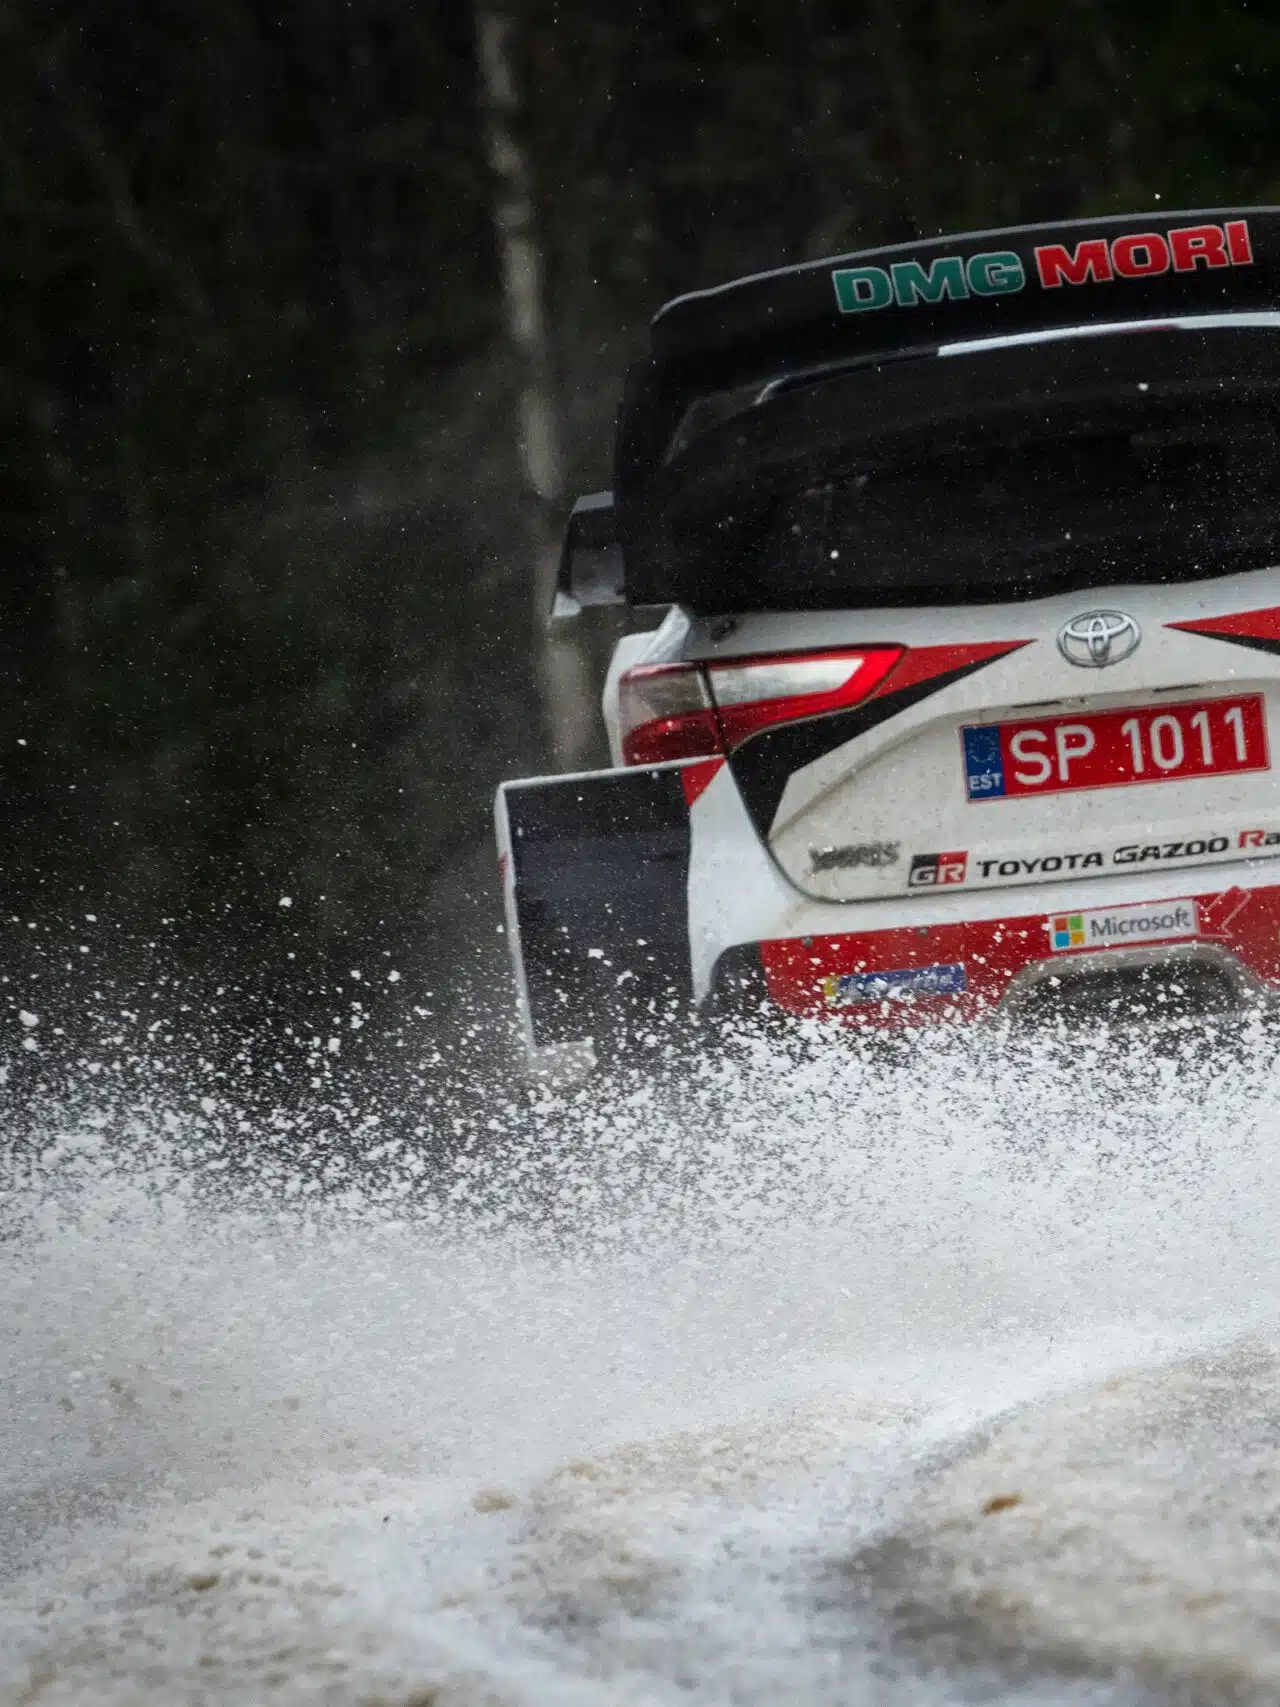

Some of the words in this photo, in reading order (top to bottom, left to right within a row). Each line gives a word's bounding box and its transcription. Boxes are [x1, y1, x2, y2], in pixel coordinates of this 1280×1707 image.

[832, 251, 1025, 315] DMG
[1034, 220, 1254, 289] MORI
[1010, 724, 1096, 785] SP
[1121, 707, 1247, 773] 1011
[970, 773, 1002, 790] EST
[910, 863, 965, 884] GR
[976, 853, 1103, 878] TOYOTA
[1113, 836, 1229, 865] GAZOO
[1090, 907, 1191, 937] Microsoft
